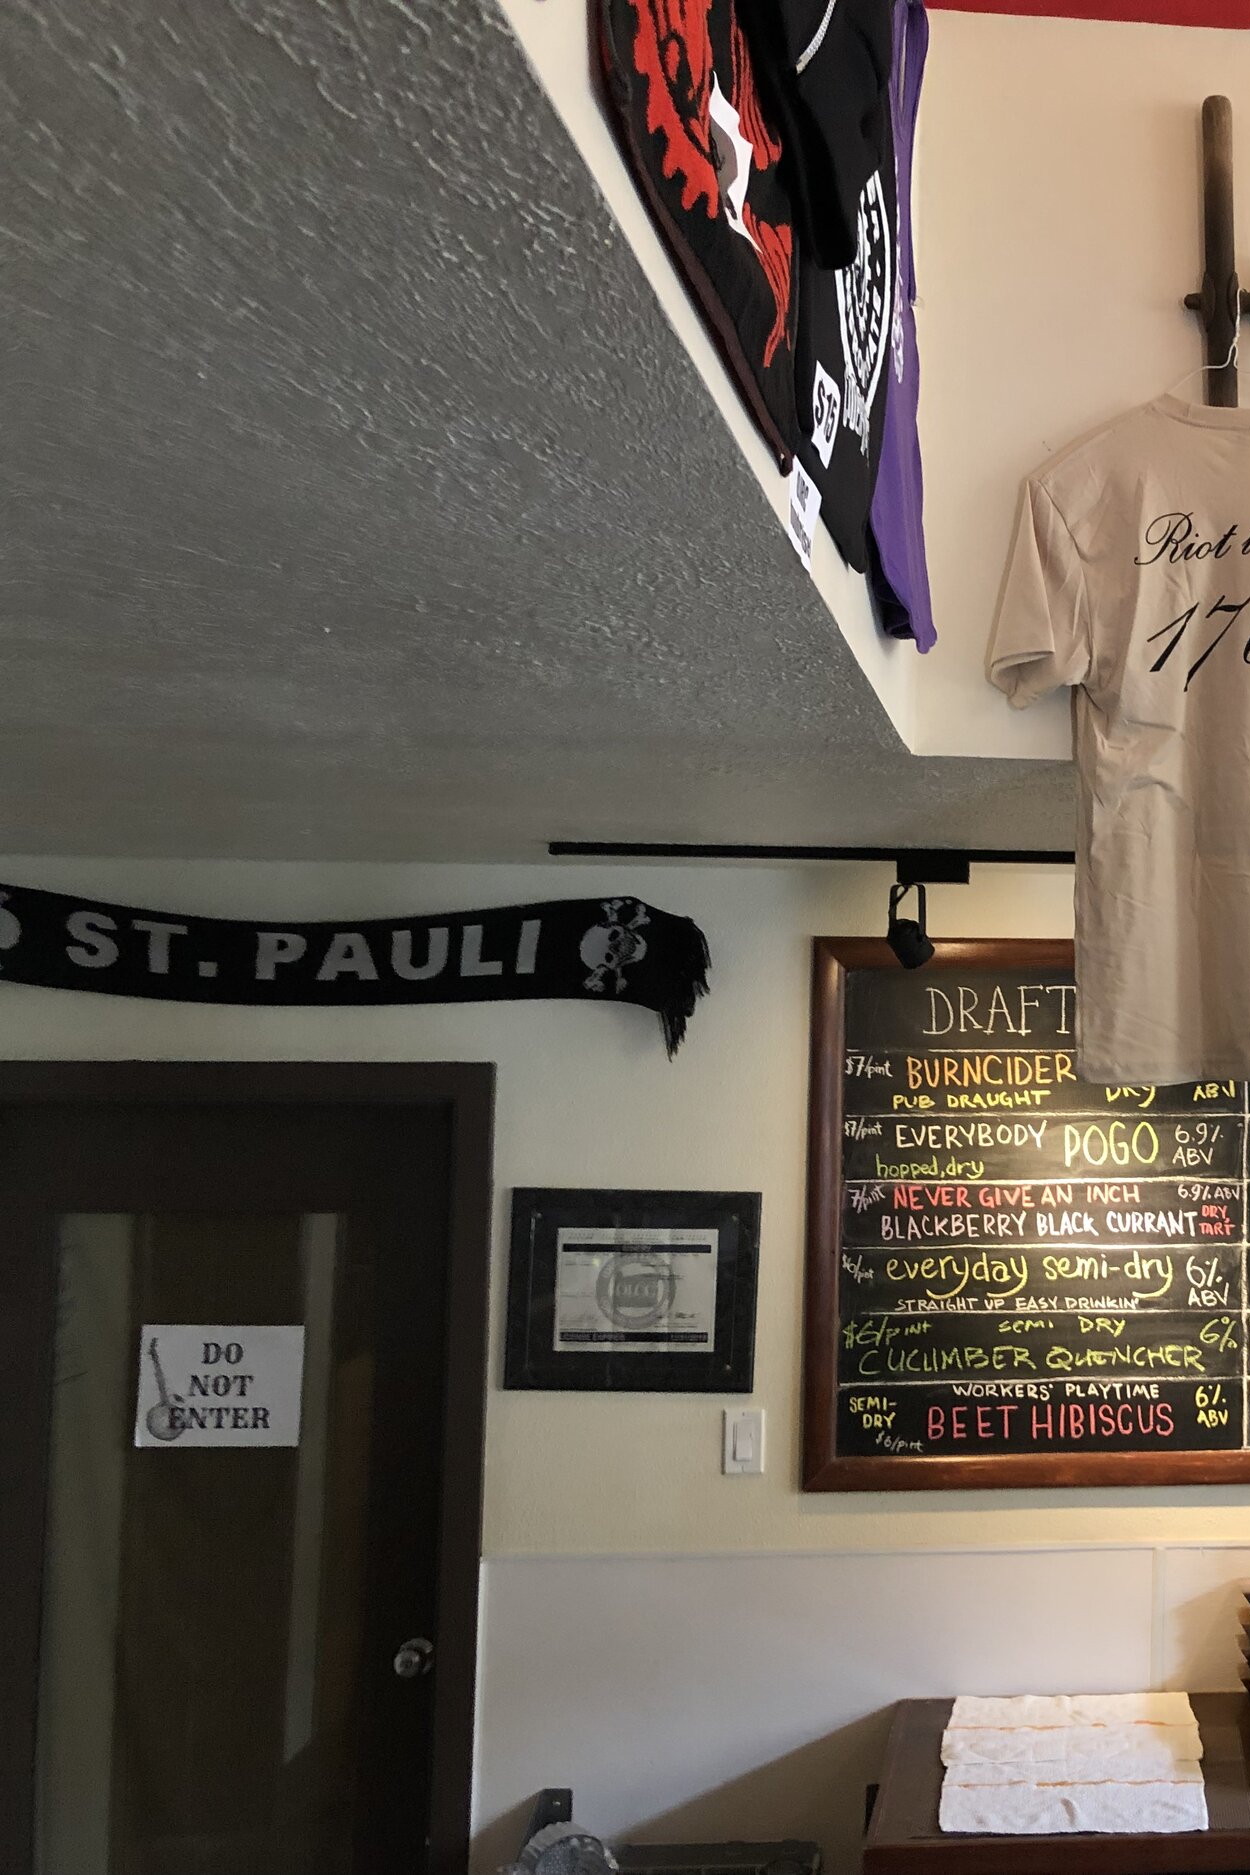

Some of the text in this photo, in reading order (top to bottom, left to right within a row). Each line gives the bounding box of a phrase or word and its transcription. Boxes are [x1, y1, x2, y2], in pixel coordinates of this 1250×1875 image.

[814, 378, 838, 443] $15
[1134, 512, 1238, 565] Riot
[66, 910, 542, 981] ST. PAULI
[922, 984, 1077, 1036] DRAFT
[907, 1054, 1077, 1090] BURNCIDER
[893, 1094, 936, 1110] PUB
[947, 1090, 1051, 1109] DRAUGHT
[896, 1120, 1047, 1149] EVERYBODY
[1064, 1120, 1159, 1167] POGO
[1172, 1146, 1213, 1167] ABV
[893, 1186, 972, 1210] NEVER
[978, 1186, 1035, 1208] GIVE
[1041, 1184, 1072, 1207] AN
[1086, 1184, 1140, 1204] INCH
[1214, 1185, 1240, 1200] ABV
[881, 1210, 1198, 1241] BLACKBERRY BLACK CURRANT
[1199, 1221, 1235, 1236] TART
[886, 1252, 1028, 1299] everyday
[1043, 1250, 1173, 1298] semi-dry
[894, 1297, 978, 1312] STRAIGHT
[984, 1298, 1005, 1310] UP
[1015, 1297, 1057, 1311] EASY
[1188, 1281, 1230, 1306] ABV
[1078, 1316, 1126, 1337] DRY
[201, 1342, 244, 1364] DO
[859, 1345, 1037, 1375] CUCUMBER
[1046, 1345, 1205, 1372] QUENCHER
[188, 1374, 254, 1397] NOT
[1065, 1383, 1160, 1400] PLAYTIME
[168, 1407, 270, 1429] ENTER
[862, 1411, 896, 1429] DRY
[927, 1403, 1229, 1440] BEET HIBISCUS ABV
